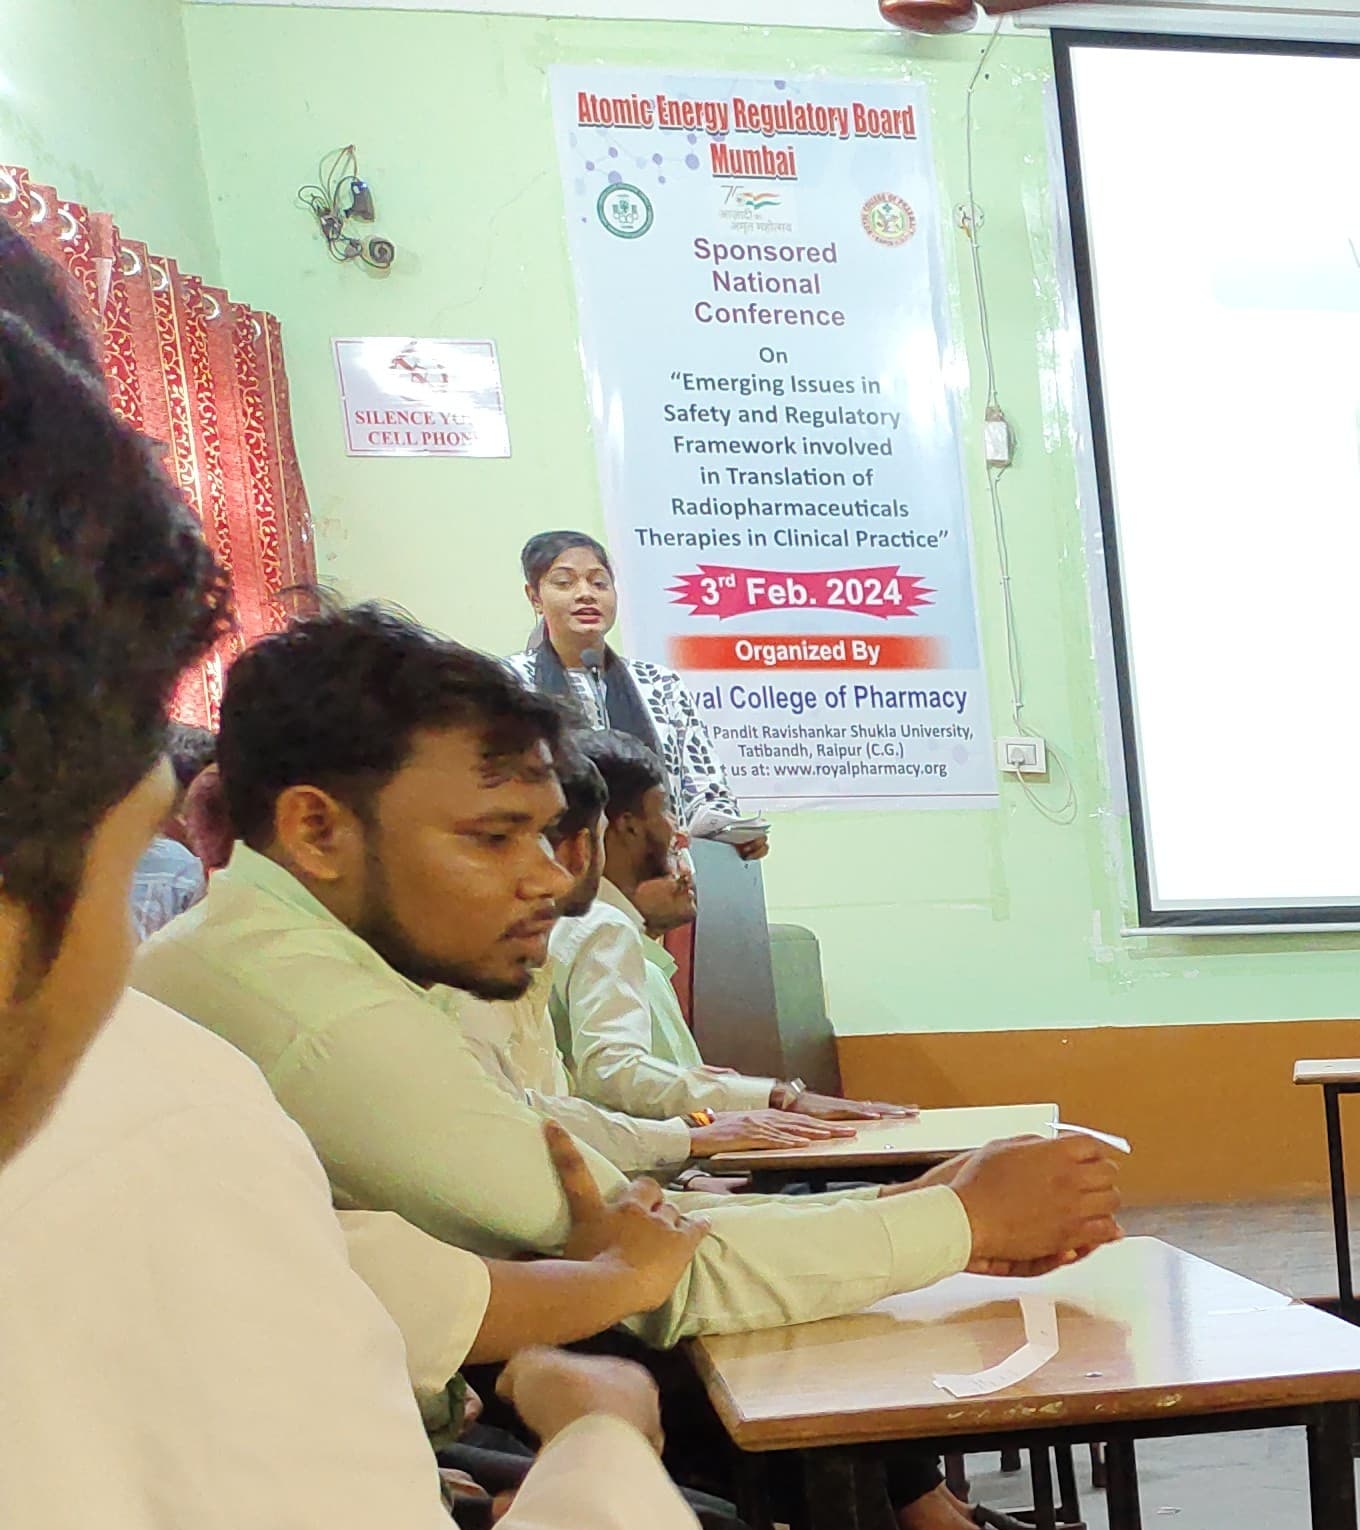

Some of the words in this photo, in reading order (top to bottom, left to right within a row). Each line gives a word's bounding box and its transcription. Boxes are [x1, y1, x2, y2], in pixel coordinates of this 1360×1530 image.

[577, 91, 654, 128] Atomic
[656, 95, 729, 134] Energy
[732, 97, 850, 138] Regulatory
[852, 103, 917, 139] Board
[710, 143, 798, 180] Mumbai
[693, 238, 838, 265] Sponsored
[711, 270, 821, 295] National
[694, 301, 846, 327] Conference
[758, 346, 789, 365] On
[790, 375, 855, 395] Issues
[861, 376, 881, 395] in
[354, 410, 436, 426] SILENCE
[663, 405, 732, 427] Safety
[738, 405, 778, 424] and
[785, 405, 901, 429] Regulatory
[367, 431, 419, 447] CELL
[673, 435, 796, 456] Framework
[802, 436, 893, 457] involved
[700, 466, 721, 486] in
[726, 467, 846, 487] Translation
[852, 467, 875, 487] of
[671, 498, 910, 521] Radiopharmaceuticals
[634, 528, 742, 551] Therapies
[747, 528, 768, 547] in
[773, 528, 850, 548] Clinical
[699, 572, 737, 606] 3rd
[746, 577, 817, 606] Feb.
[825, 577, 902, 606] 2024
[734, 639, 847, 667] Organized
[851, 641, 881, 666] By
[729, 685, 818, 715] College
[824, 684, 847, 709] of
[853, 684, 968, 715] Pharmacy
[713, 724, 759, 740] Pandit
[762, 724, 847, 740] Ravishankar
[850, 724, 897, 739] Shukla
[900, 723, 974, 741] University,
[737, 741, 813, 760] Tatibandh,
[816, 743, 862, 761] Raipur
[865, 741, 905, 759] (C.G.)
[731, 764, 748, 777] us
[751, 763, 771, 777] at:
[773, 760, 948, 779] www.royalpharmacy.org
